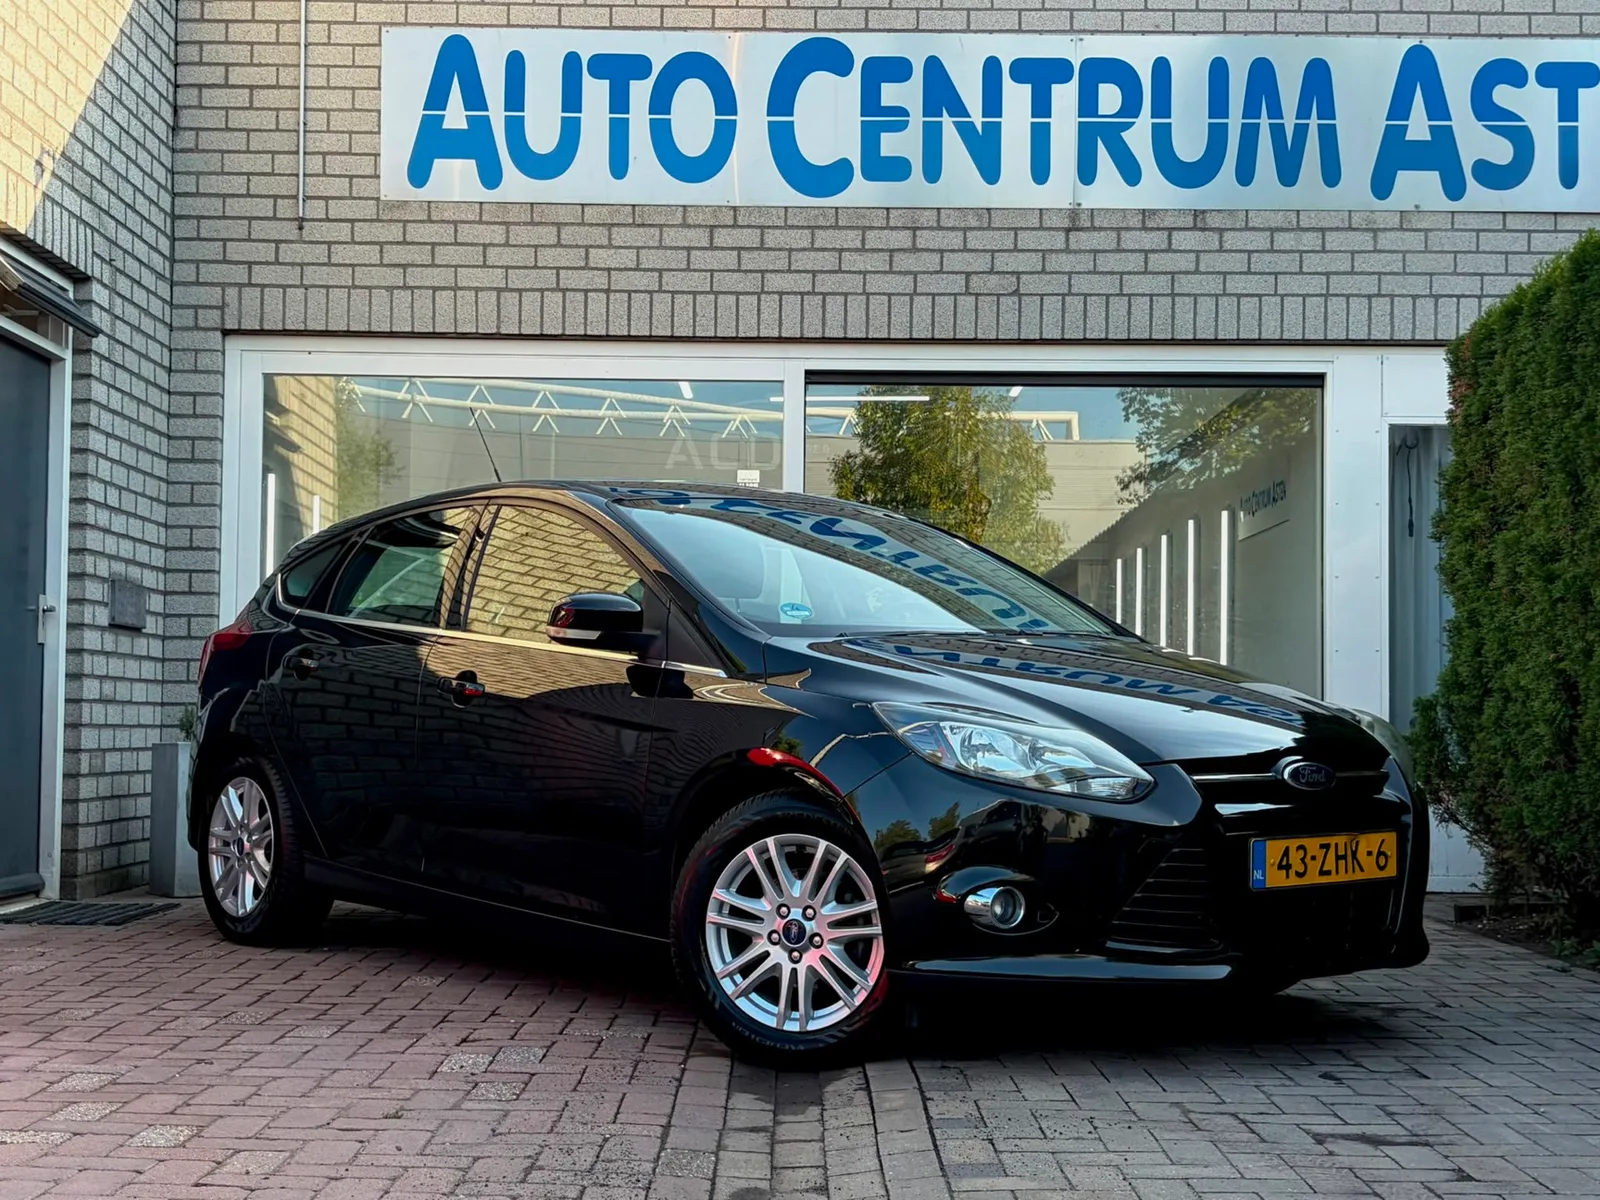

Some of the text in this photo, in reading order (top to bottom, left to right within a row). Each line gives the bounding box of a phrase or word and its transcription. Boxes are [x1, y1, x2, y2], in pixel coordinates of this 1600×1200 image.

[407, 34, 738, 190] AUTO
[766, 37, 1342, 199] CENTRUM
[1299, 766, 1326, 783] Ford
[1276, 838, 1389, 880] 43-ZHK-6
[1253, 869, 1265, 880] NL
